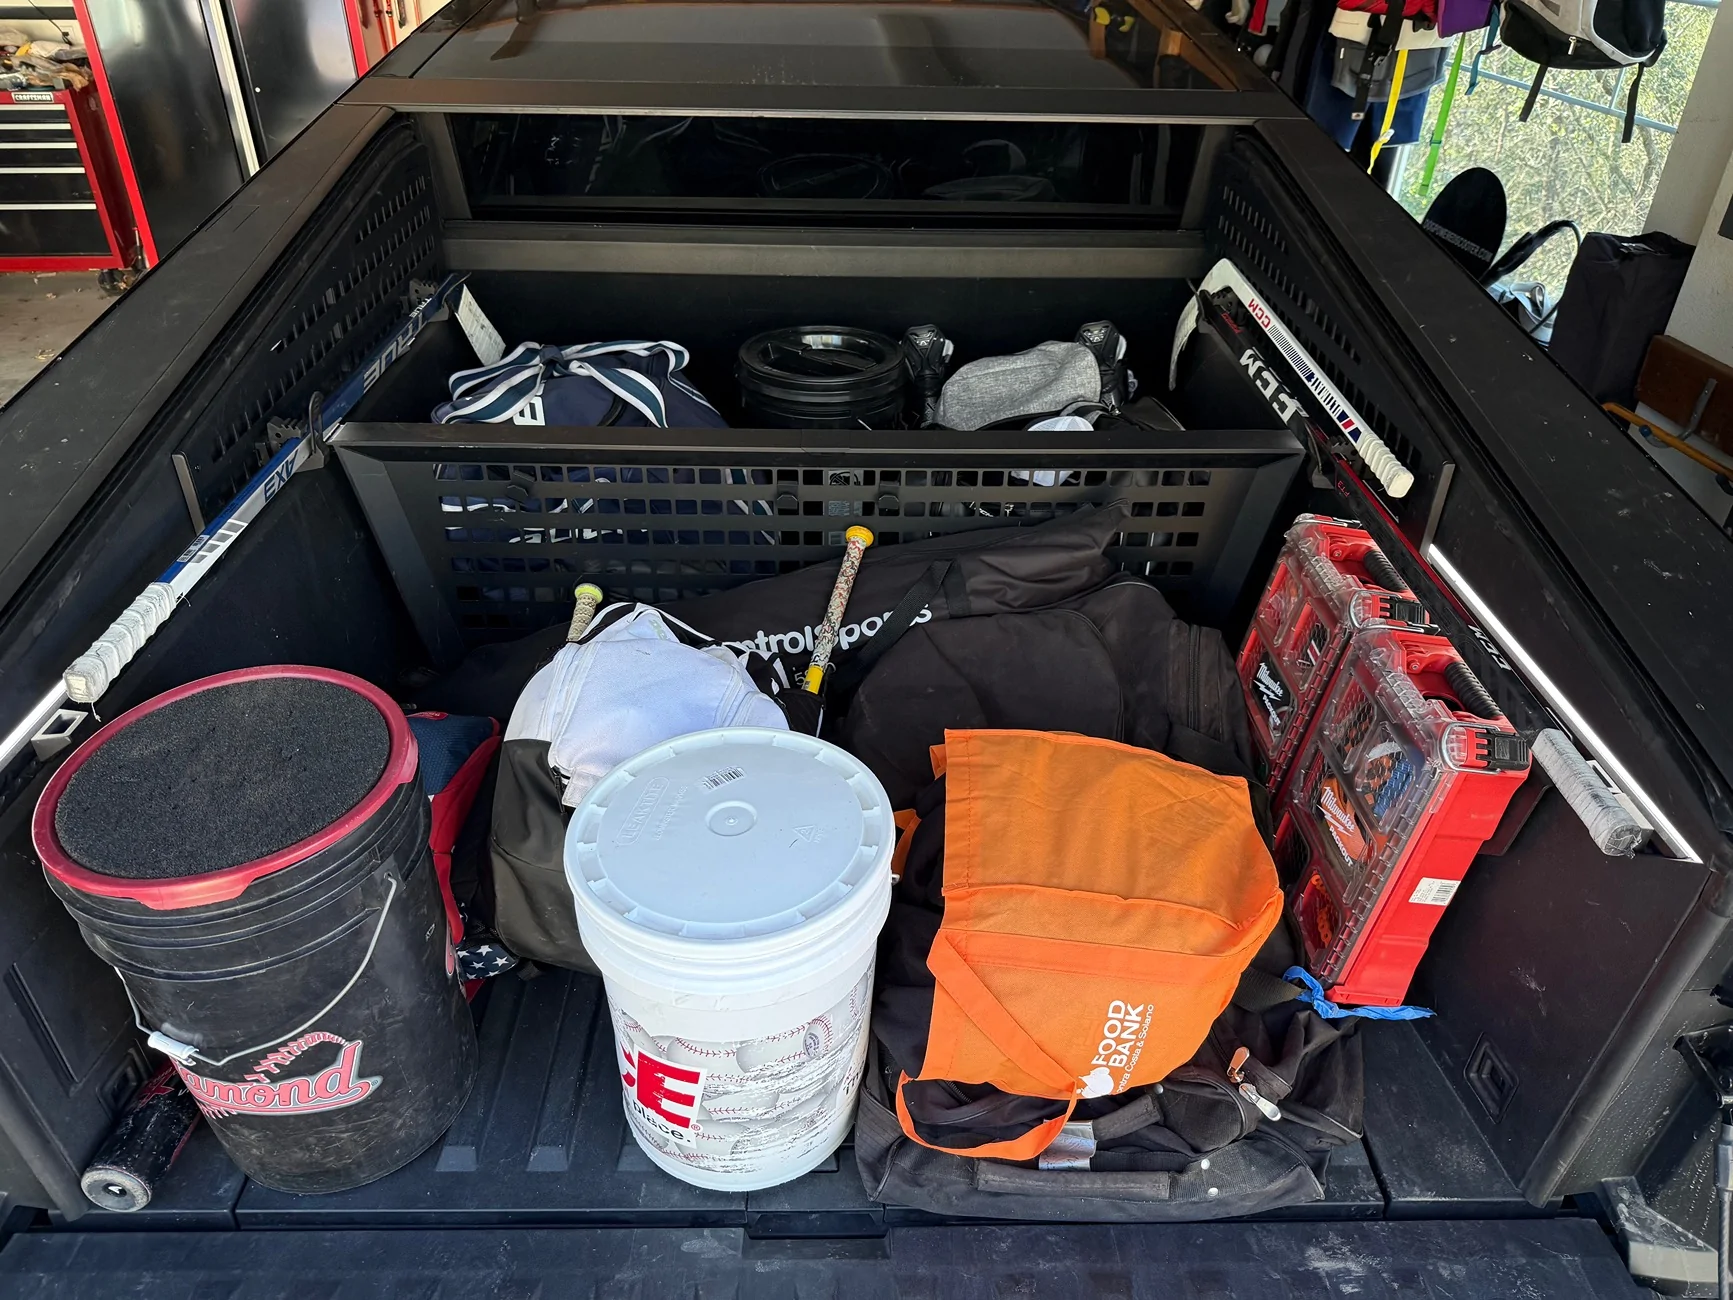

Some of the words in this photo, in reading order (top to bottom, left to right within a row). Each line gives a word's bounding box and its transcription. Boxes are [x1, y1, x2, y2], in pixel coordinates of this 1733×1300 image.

[409, 298, 433, 319] TRUE
[1248, 298, 1272, 329] CCM
[363, 312, 424, 394] TRUE
[1239, 349, 1298, 425] CCM
[1467, 624, 1512, 671] CCM
[1256, 662, 1284, 697] Milwaukee
[1320, 786, 1356, 832] Milwaukee
[1329, 825, 1354, 867] PACKOUT
[1090, 1000, 1126, 1066] FOOD
[1107, 1003, 1145, 1068] BANK
[1138, 1004, 1154, 1040] Solano
[1124, 1048, 1142, 1073] Costa
[1135, 1040, 1145, 1048] &
[1116, 1073, 1131, 1094] ontra
